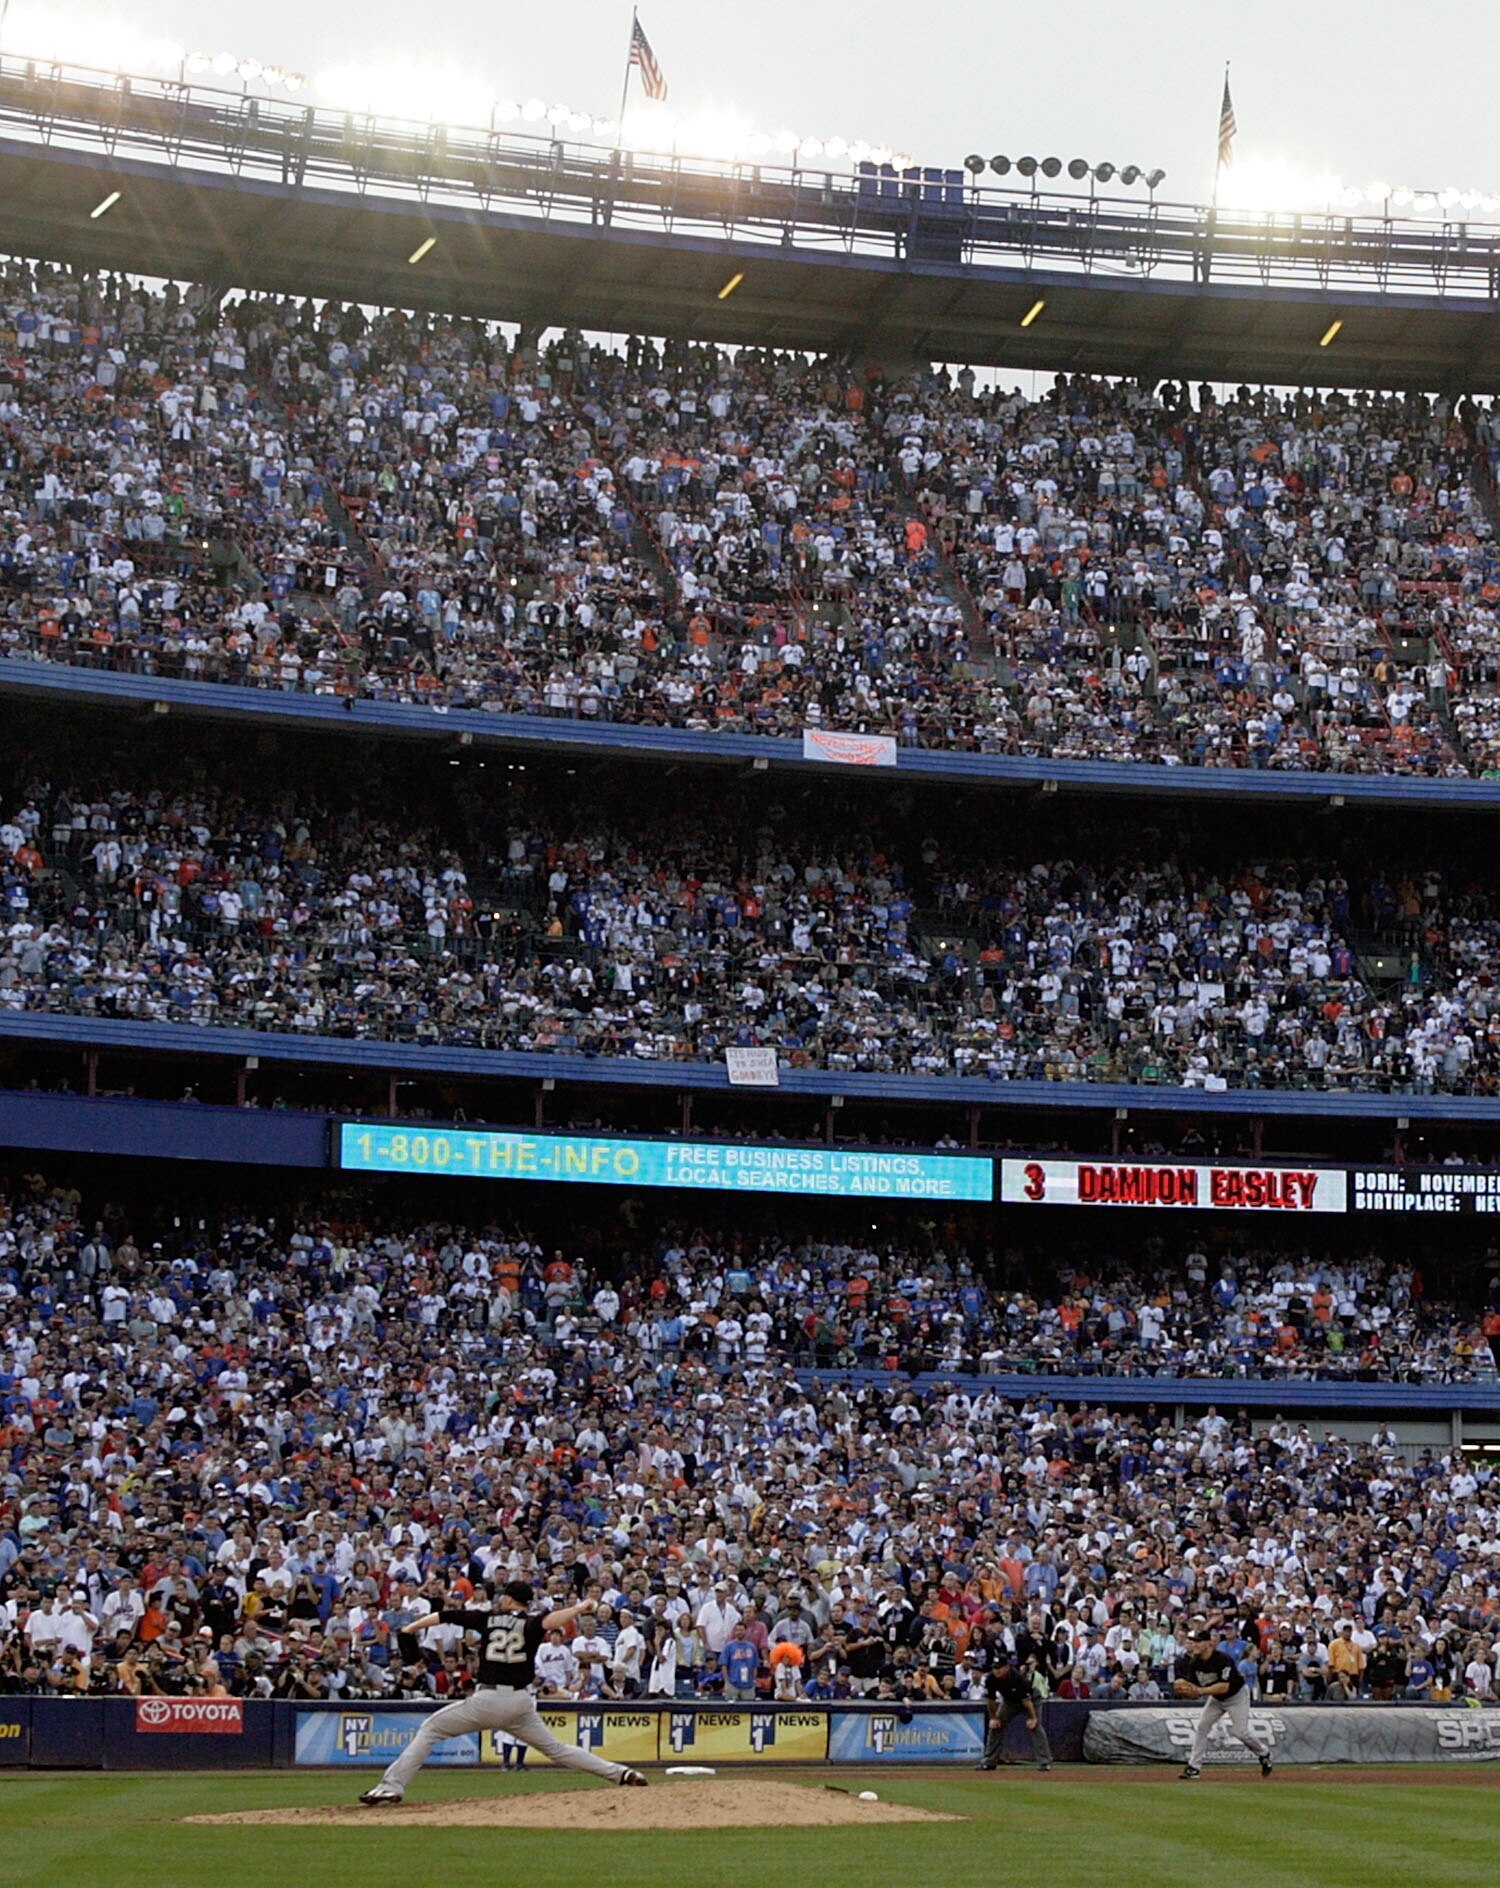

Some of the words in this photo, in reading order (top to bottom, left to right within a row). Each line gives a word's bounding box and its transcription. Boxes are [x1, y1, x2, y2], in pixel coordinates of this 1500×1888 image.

[357, 1133, 640, 1176] 1-800-THE-INFO
[667, 1147, 719, 1165] FREE
[726, 1150, 824, 1170] BUSINESS
[831, 1155, 926, 1176] LISTINGS,
[667, 1167, 732, 1185] LOCAL
[737, 1171, 845, 1192] SEARCHES,
[851, 1175, 891, 1193] AND
[896, 1178, 955, 1195] MORE.
[1024, 1163, 1045, 1200] 3
[1078, 1165, 1198, 1205] DAMION
[1210, 1169, 1317, 1209] EASLEY
[1355, 1173, 1406, 1191] BORN:
[1355, 1192, 1461, 1212] BIRTHPLACE:
[485, 1629, 528, 1663] 22
[172, 1704, 241, 1720] TOYOTA
[579, 1716, 600, 1728] NY
[606, 1716, 651, 1727] NEWS
[672, 1714, 694, 1726] NY
[698, 1715, 741, 1726] NEWS
[753, 1715, 773, 1727] NY
[778, 1716, 820, 1727] NEWS
[346, 1718, 367, 1731] NY
[873, 1719, 893, 1730] NY
[346, 1732, 358, 1756] 1
[579, 1729, 591, 1752] 1
[672, 1727, 684, 1752] 1
[753, 1727, 764, 1752] 1
[873, 1731, 884, 1754] 1
[883, 1727, 949, 1746] noticias
